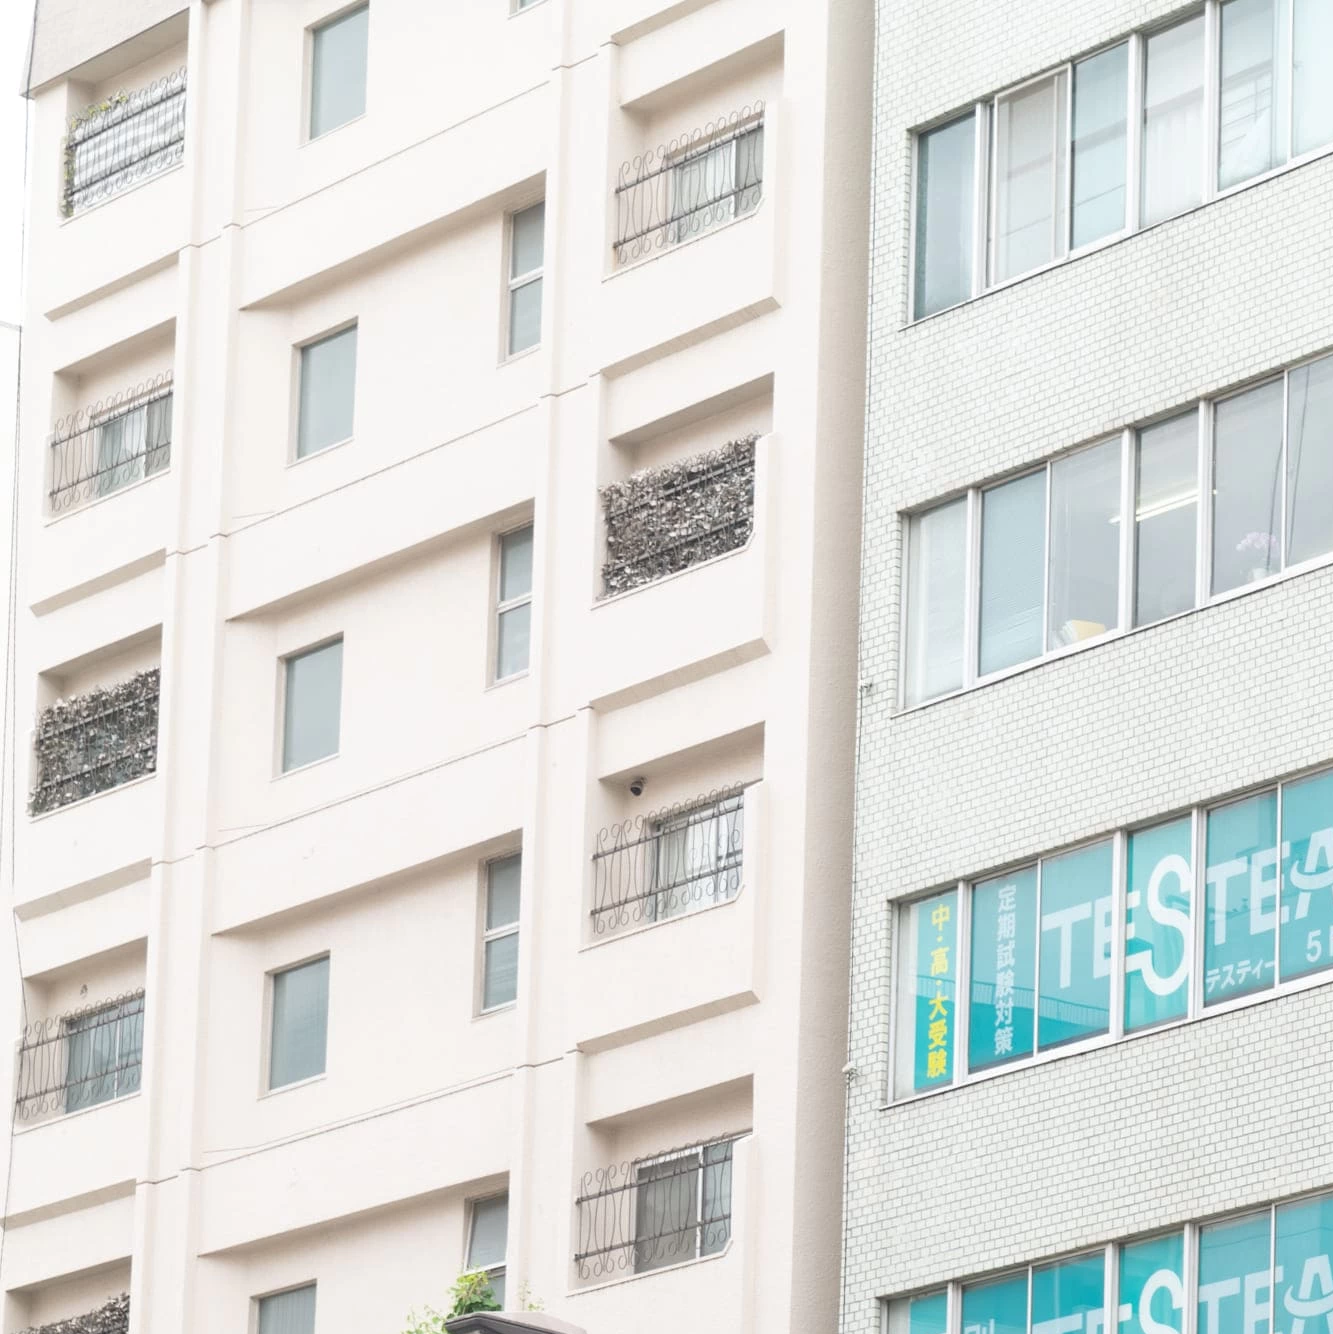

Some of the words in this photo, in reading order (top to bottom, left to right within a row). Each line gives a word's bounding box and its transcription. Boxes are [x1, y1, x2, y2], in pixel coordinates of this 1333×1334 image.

[926, 903, 950, 1079] 中・高・大受験
[993, 884, 1017, 1056] 定期試験対策
[1205, 959, 1276, 994] テスティー
